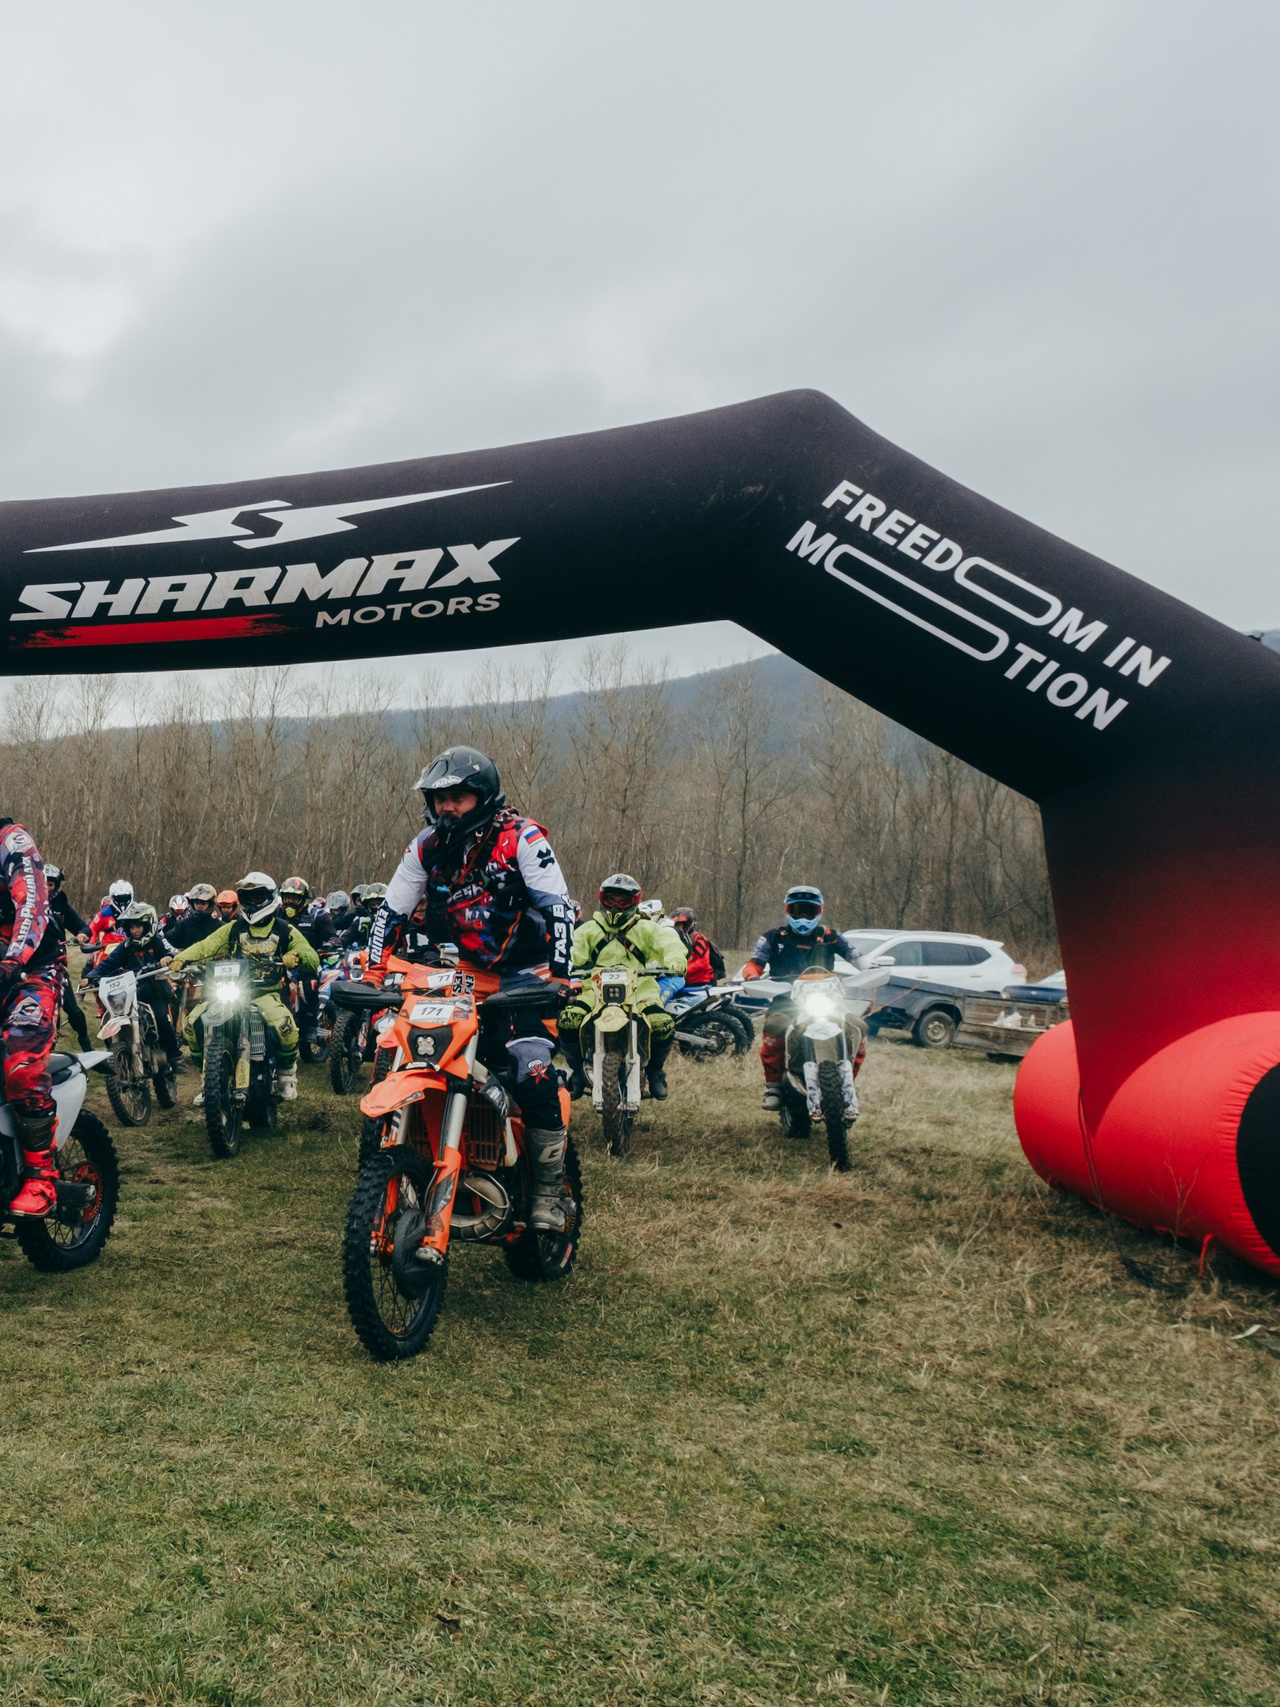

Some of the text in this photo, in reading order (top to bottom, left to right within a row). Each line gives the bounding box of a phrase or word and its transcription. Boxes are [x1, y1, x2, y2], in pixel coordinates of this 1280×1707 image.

[9, 537, 521, 621] SHARMAX
[316, 593, 501, 628] MOTORS
[822, 479, 1172, 687] FREEDOM IN
[786, 521, 1129, 731] MOTION
[370, 908, 389, 964] ENDURO
[421, 1006, 442, 1016] 171
